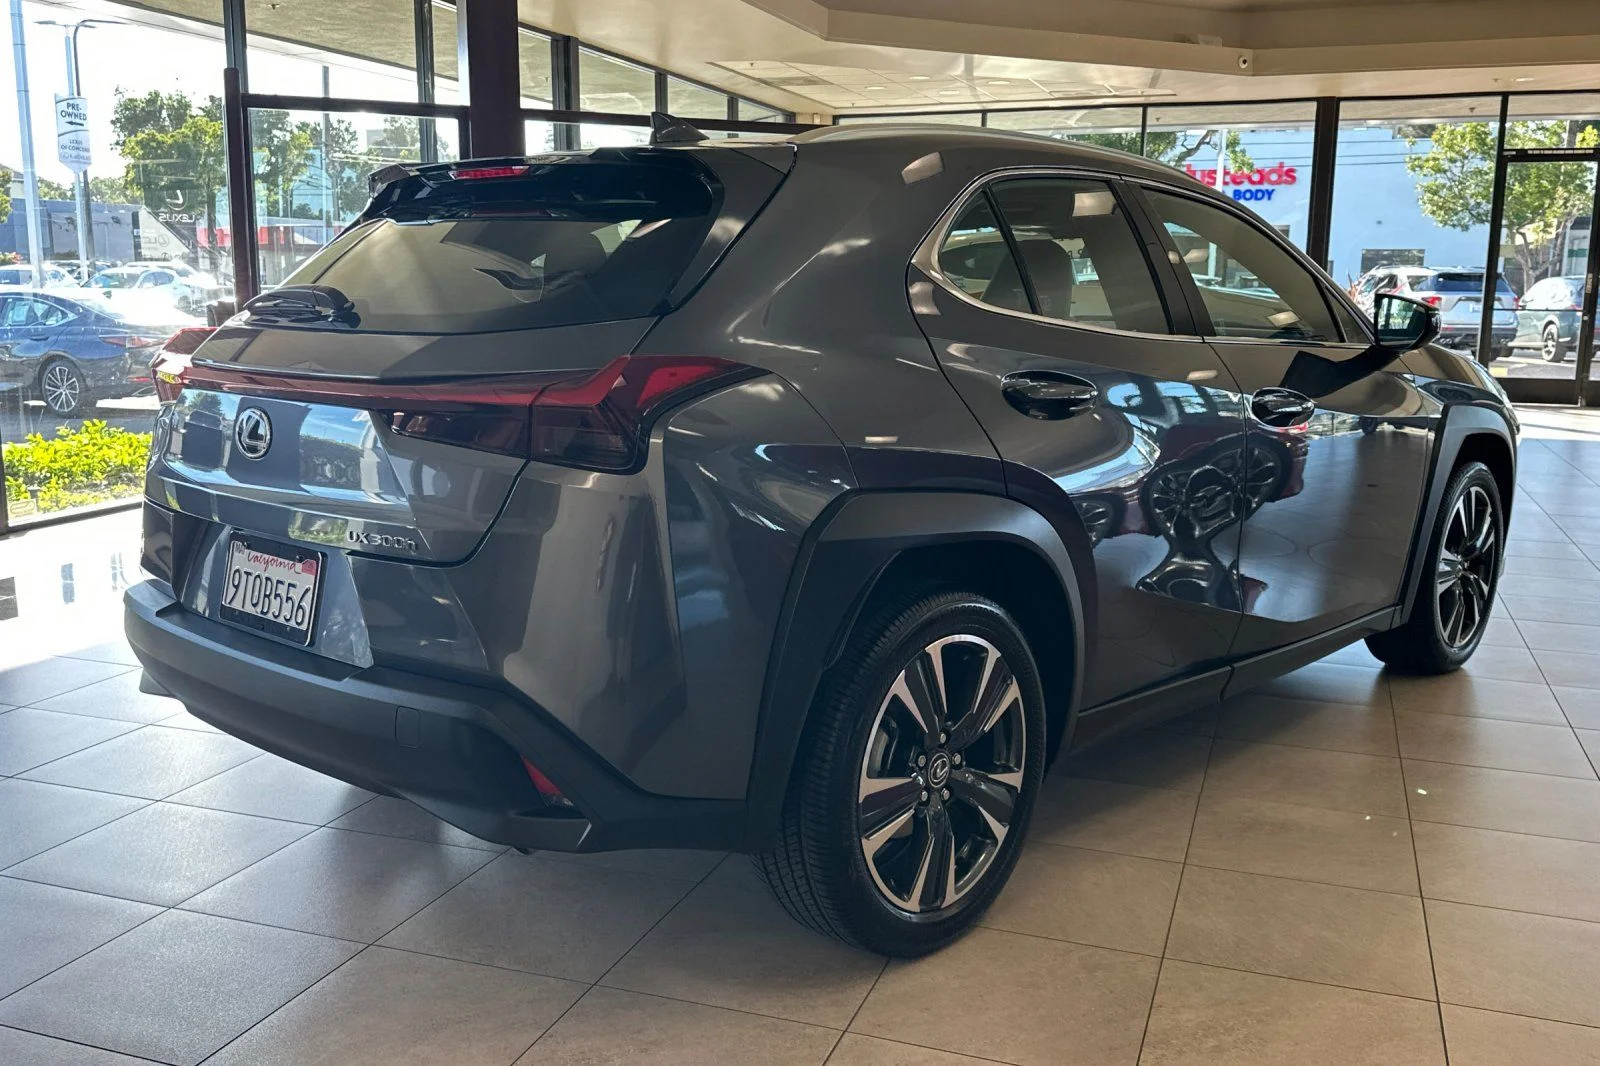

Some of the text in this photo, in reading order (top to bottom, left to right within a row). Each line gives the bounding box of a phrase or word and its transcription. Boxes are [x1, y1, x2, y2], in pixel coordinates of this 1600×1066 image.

[66, 102, 82, 111] PRE-
[60, 110, 88, 121] OWNED
[1232, 188, 1275, 202] BODY
[247, 551, 296, 572] California
